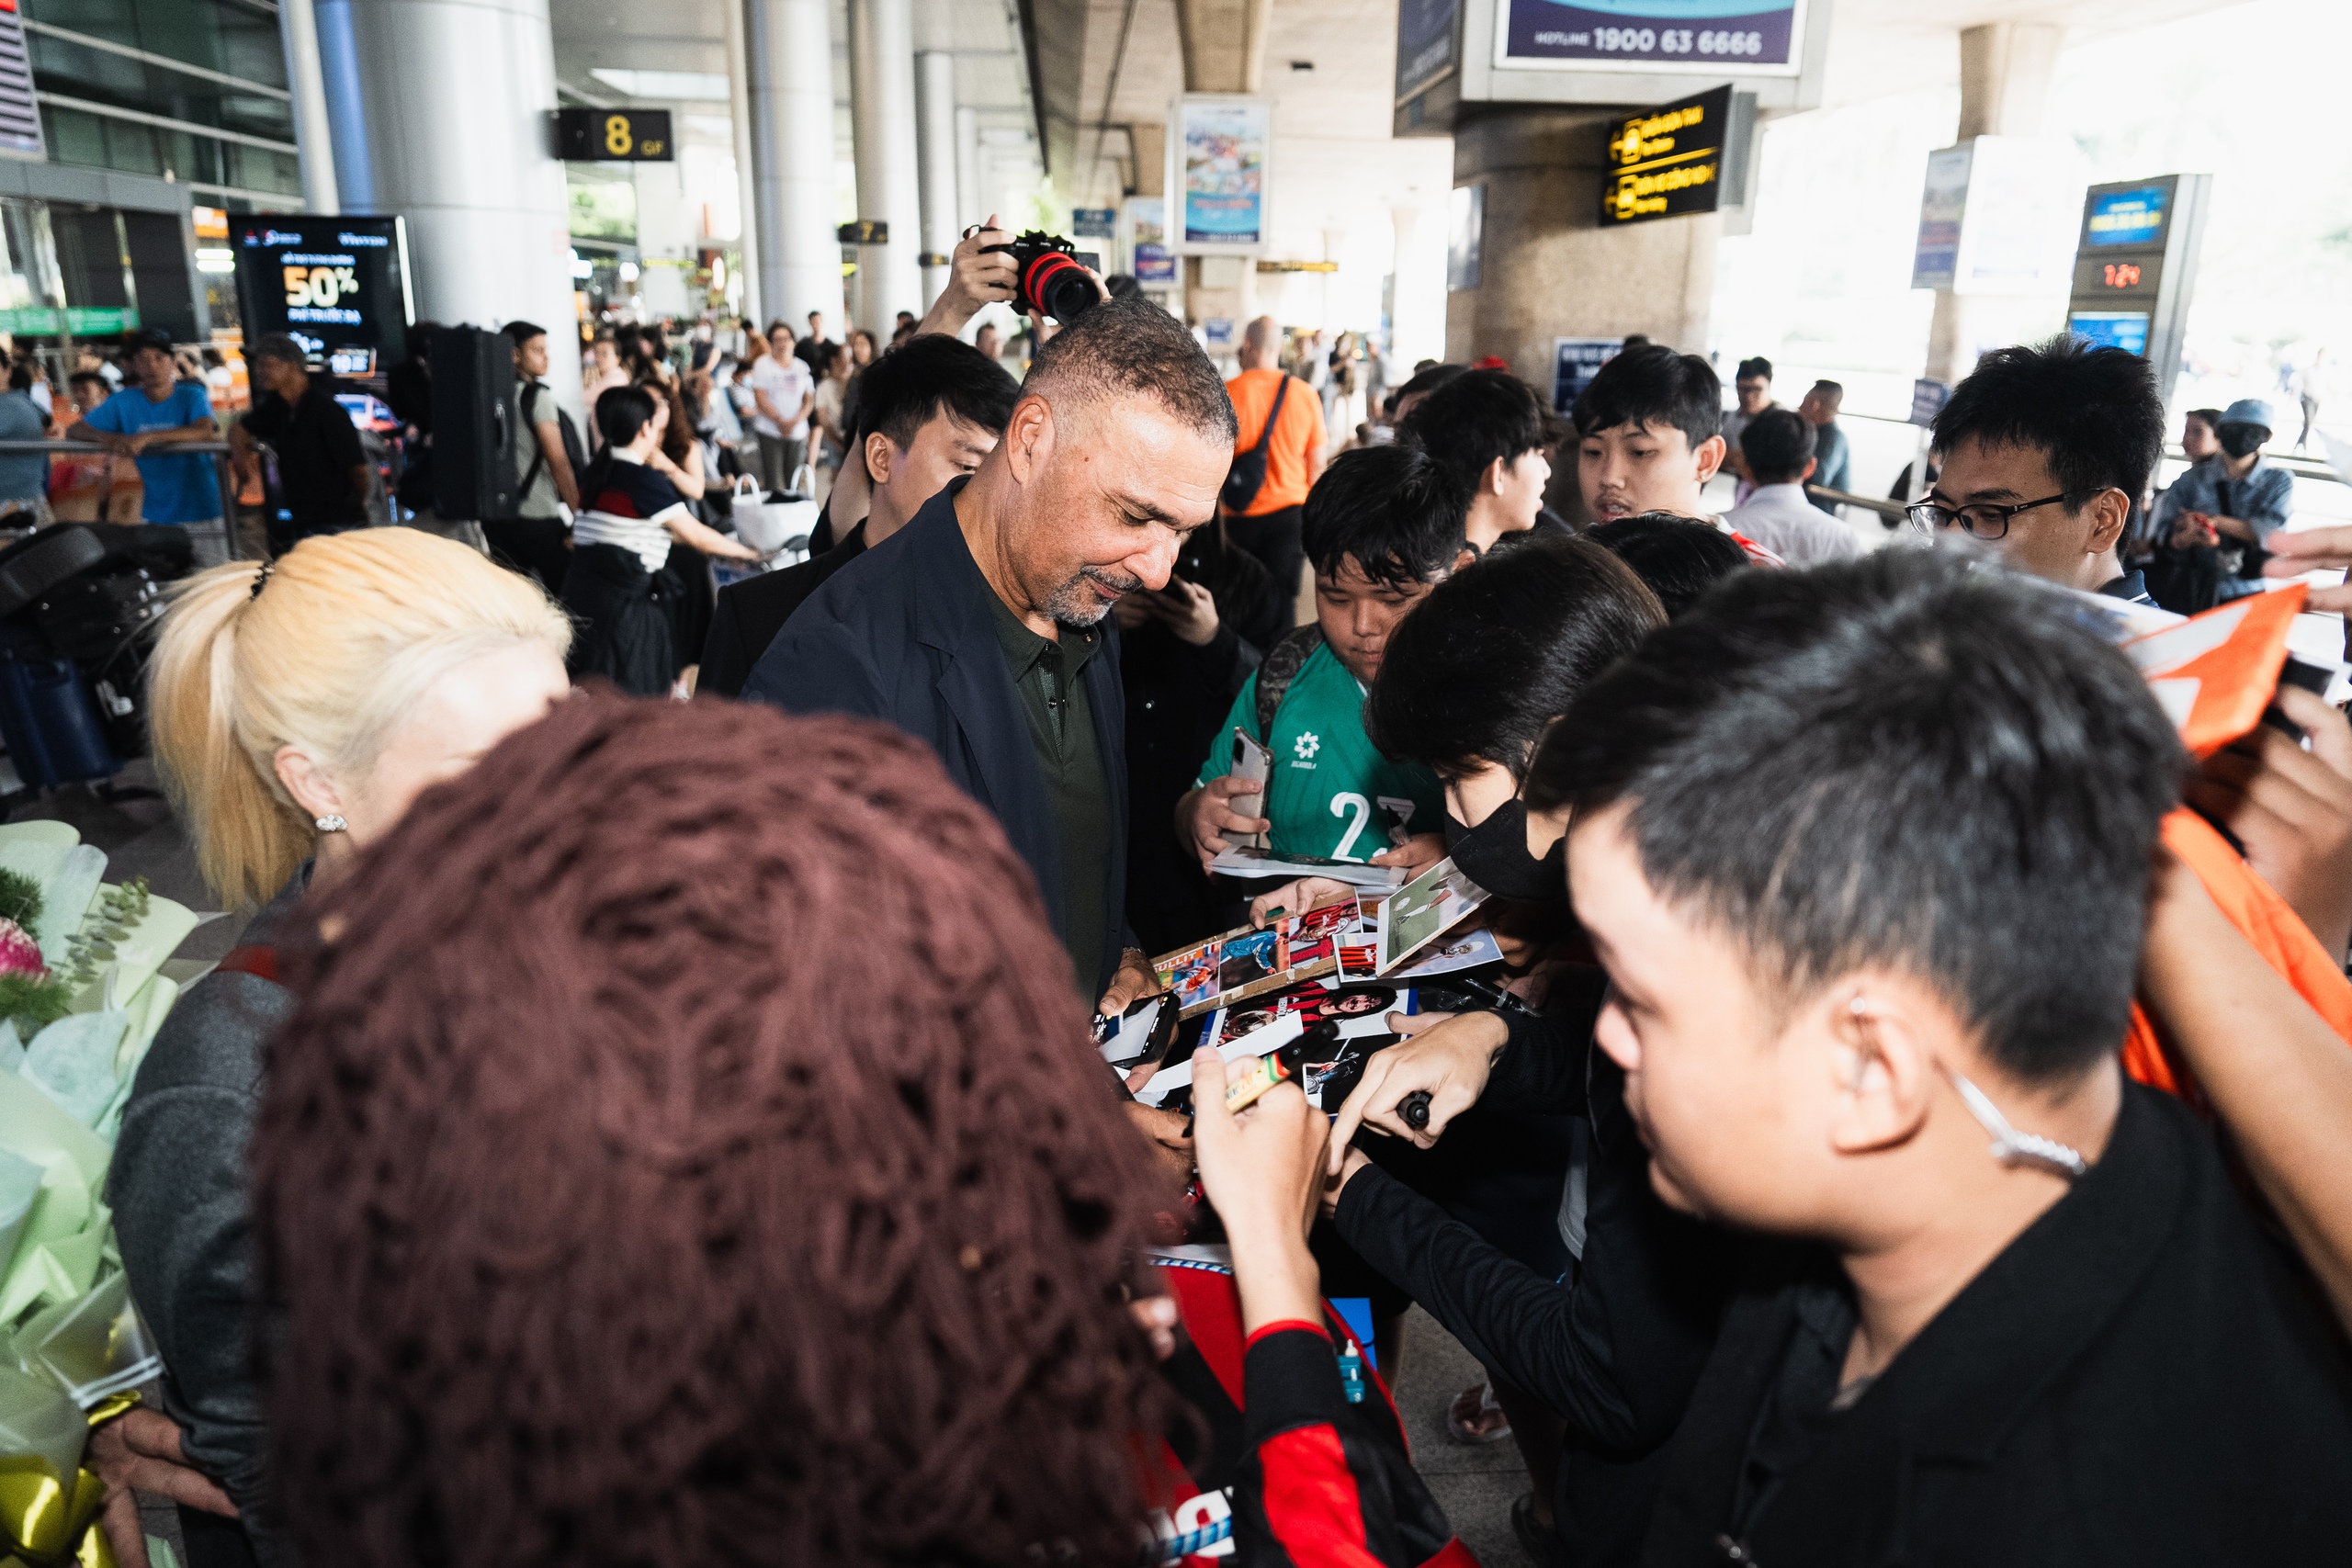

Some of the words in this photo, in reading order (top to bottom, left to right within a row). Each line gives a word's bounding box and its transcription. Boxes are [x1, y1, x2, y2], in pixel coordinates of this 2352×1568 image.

[1534, 30, 1590, 46] HOTLINE
[1593, 28, 1656, 51] 1900
[1660, 29, 1693, 53] 63
[1698, 30, 1763, 56] 6666
[605, 114, 633, 156] 8
[282, 265, 360, 308] 50%
